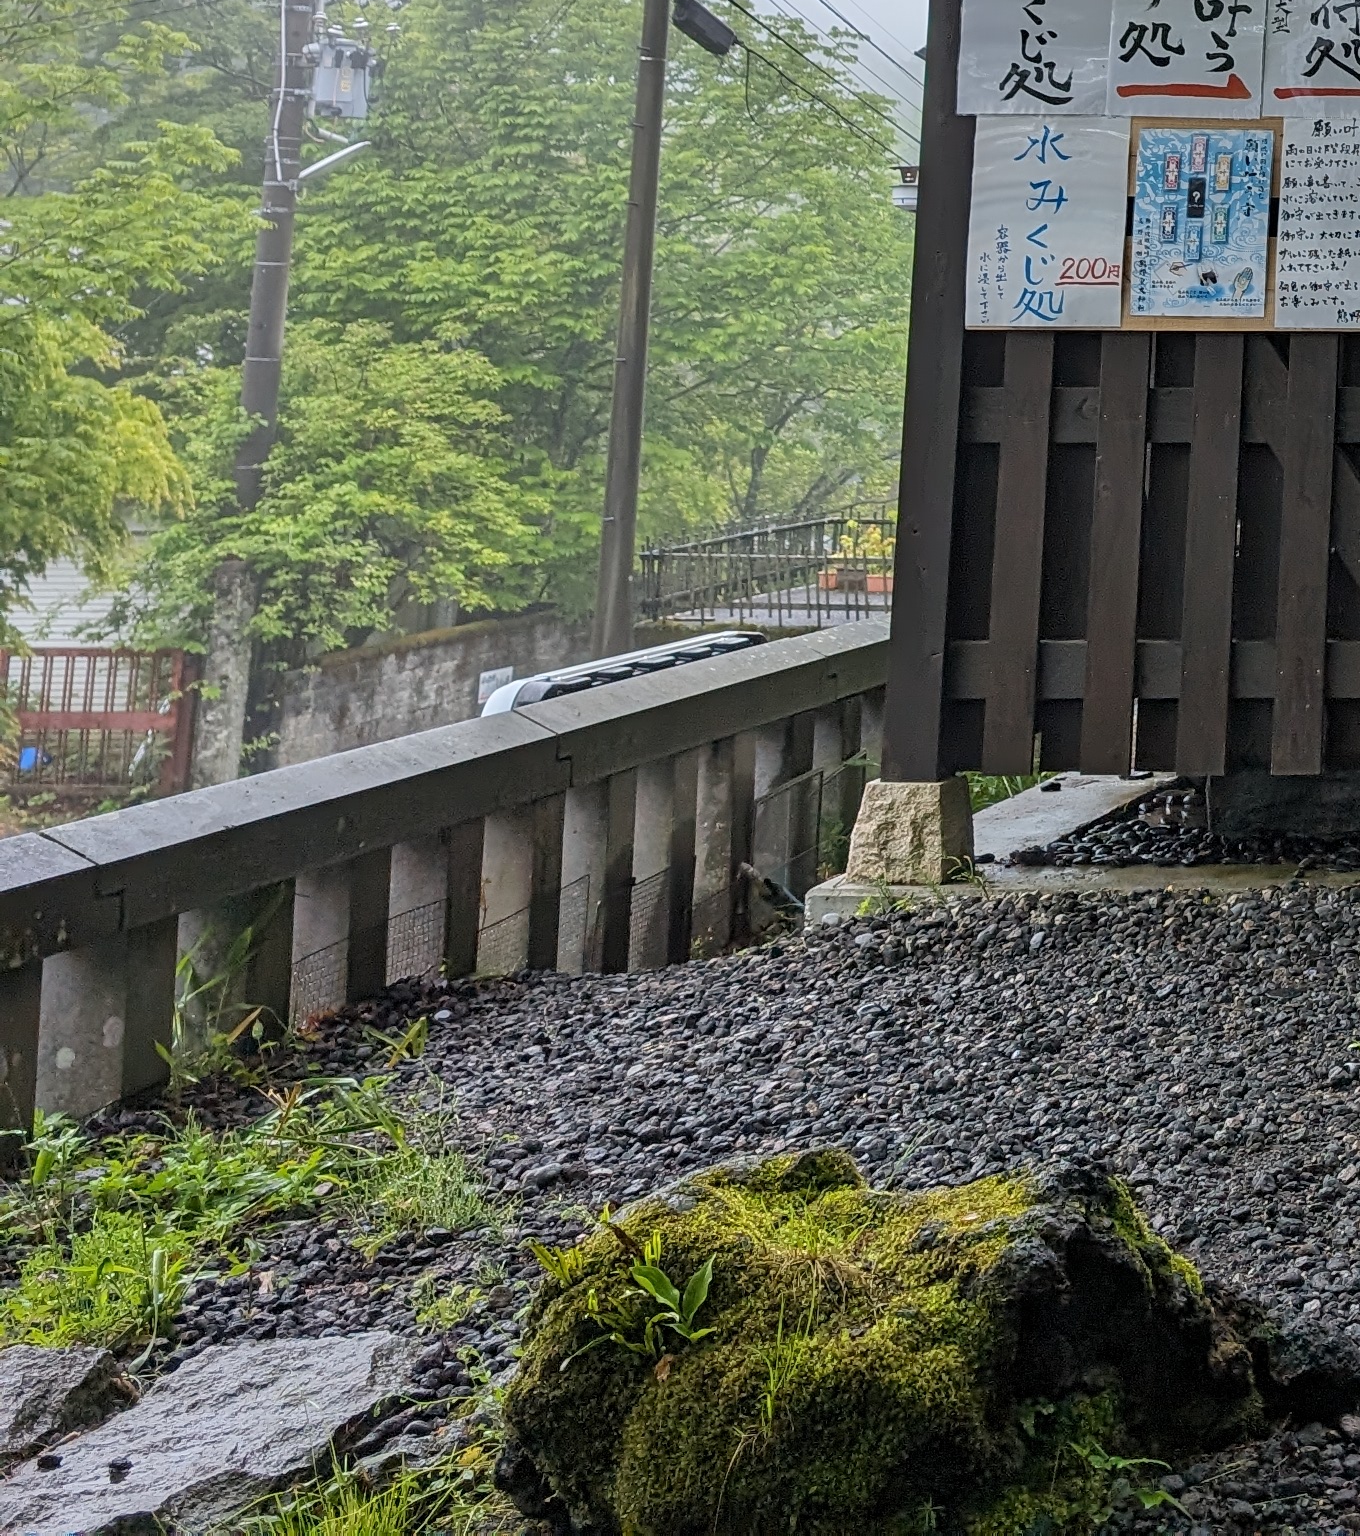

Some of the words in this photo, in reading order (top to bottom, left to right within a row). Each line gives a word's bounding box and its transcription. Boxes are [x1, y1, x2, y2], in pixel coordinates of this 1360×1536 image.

[1010, 125, 1073, 322] 水みくじ処
[995, 224, 1012, 300] 容器から出して
[1058, 257, 1121, 281] 200円
